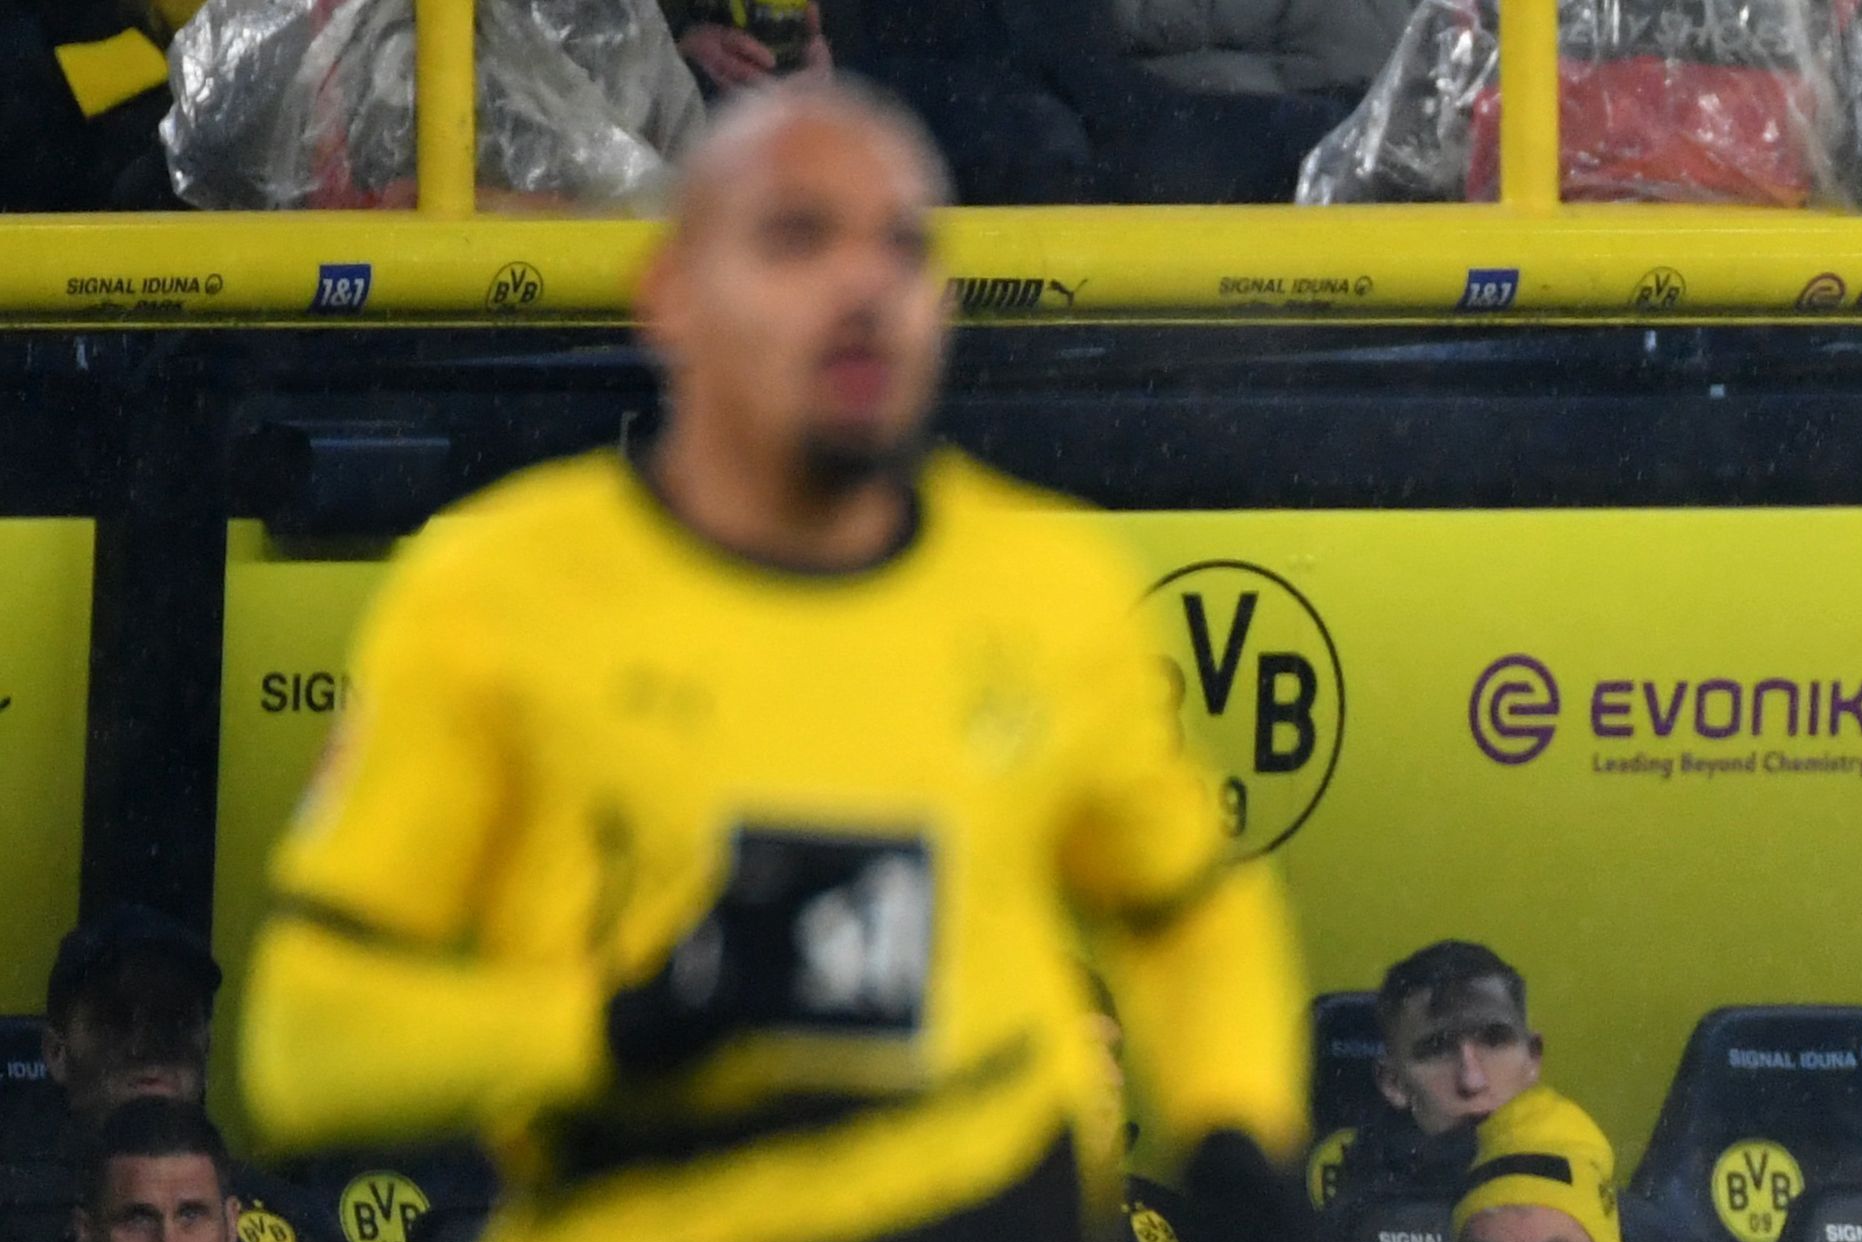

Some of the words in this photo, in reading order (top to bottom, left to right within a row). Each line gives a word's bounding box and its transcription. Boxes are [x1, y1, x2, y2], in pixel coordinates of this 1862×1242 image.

[66, 277, 135, 295] SIGNAL
[141, 277, 200, 294] IDUNA
[320, 279, 367, 305] 1&1
[493, 270, 541, 304] BVB
[1219, 277, 1286, 295] SIGNAL
[1292, 278, 1349, 295] IDUNA
[1467, 281, 1512, 308] 1&1
[1728, 1049, 1796, 1069] SIGNAL
[1800, 1051, 1856, 1069] IDUNA
[1726, 1151, 1791, 1212] BVB
